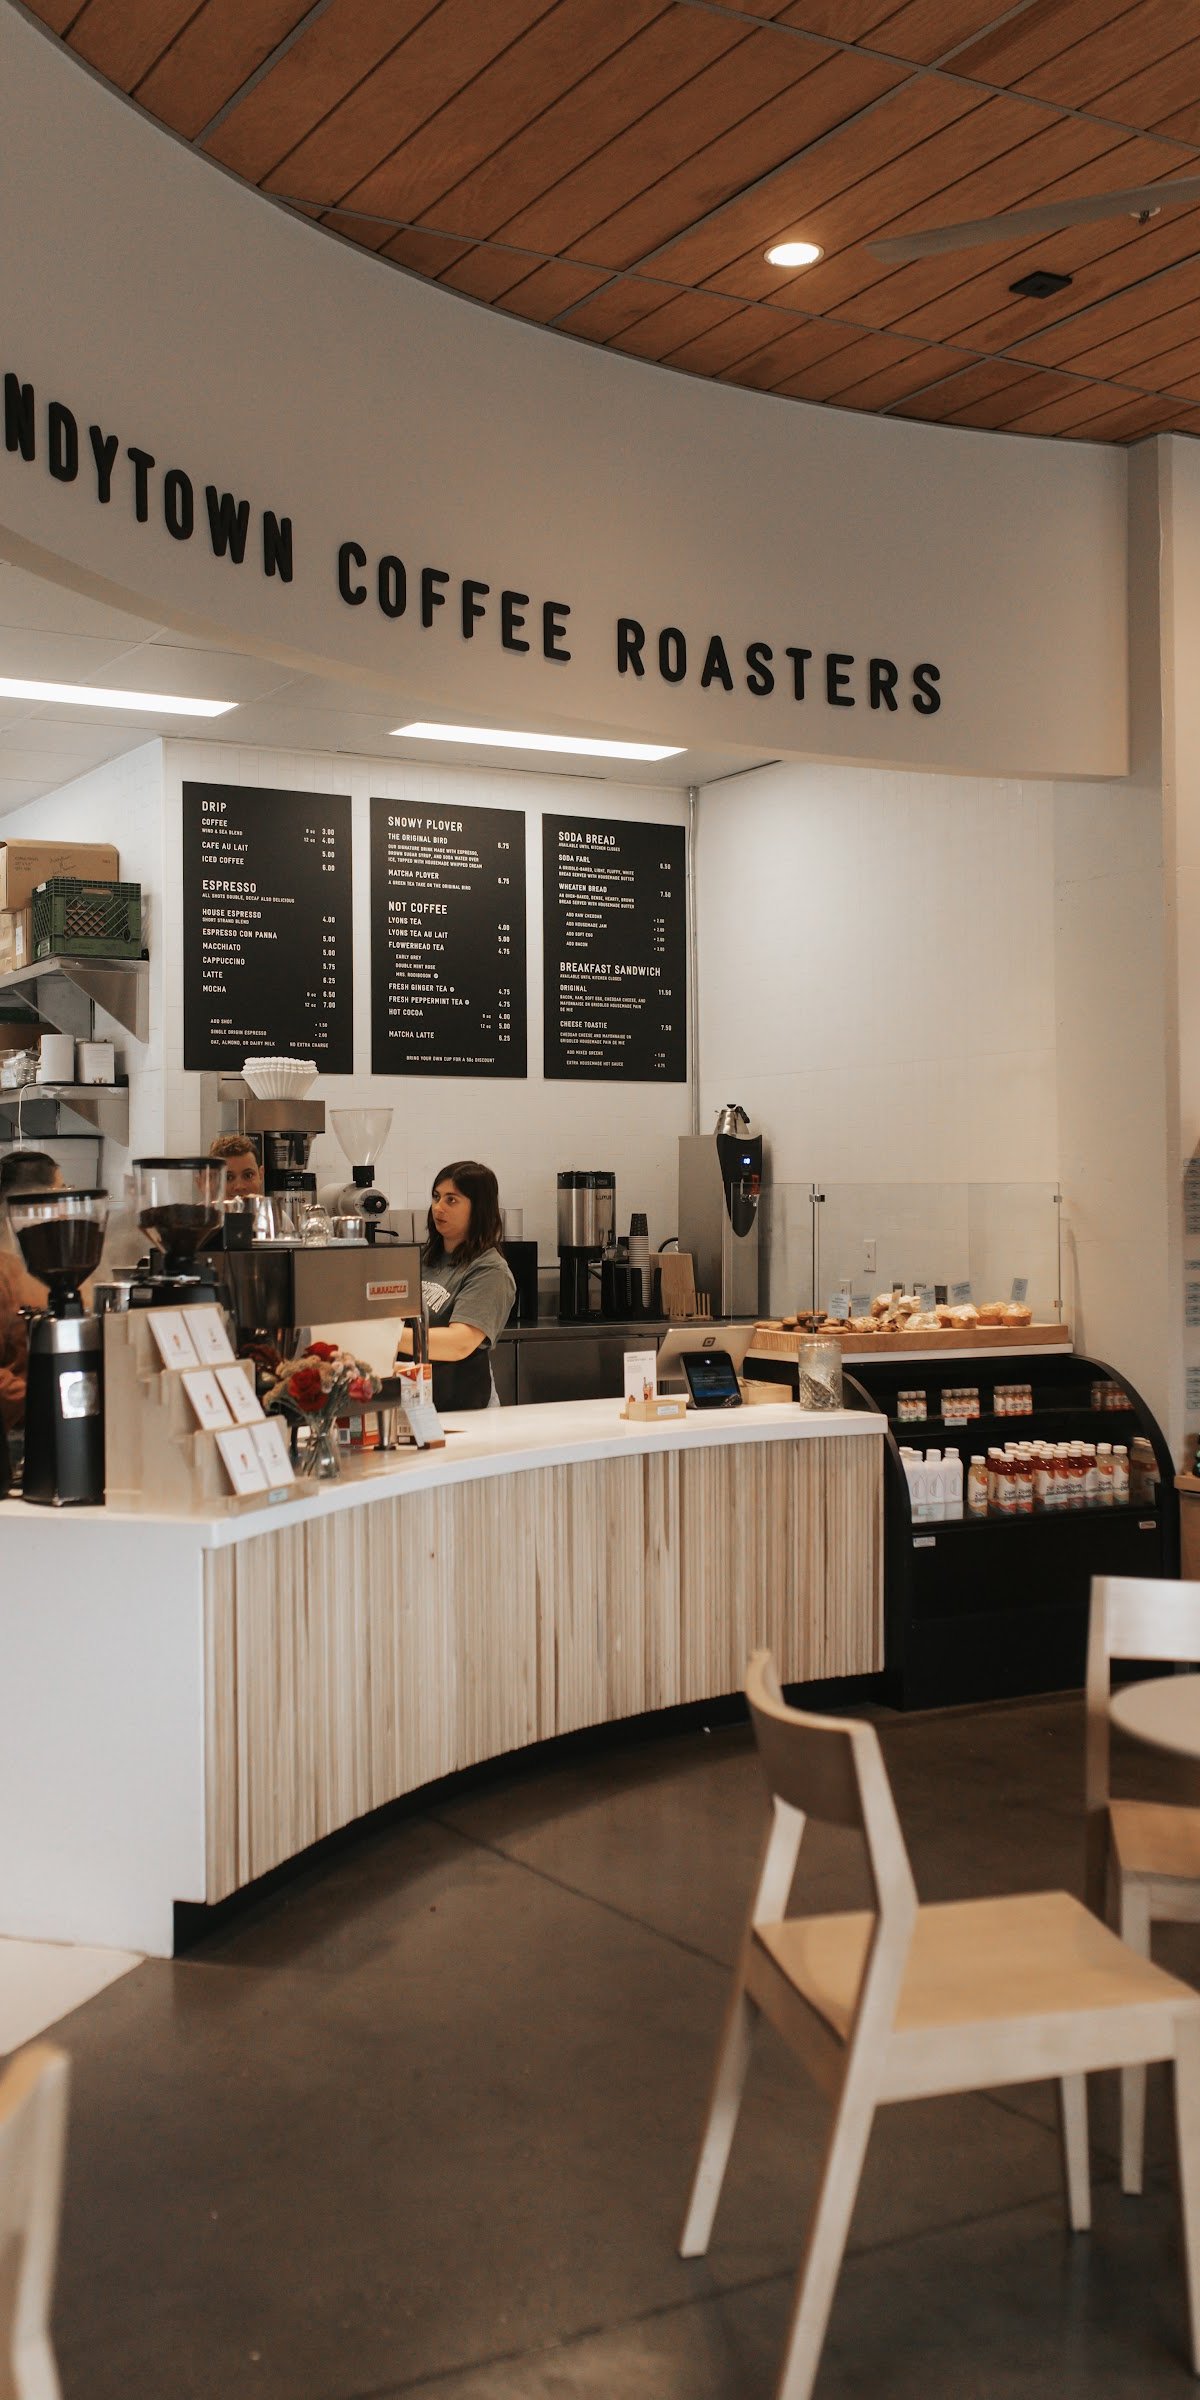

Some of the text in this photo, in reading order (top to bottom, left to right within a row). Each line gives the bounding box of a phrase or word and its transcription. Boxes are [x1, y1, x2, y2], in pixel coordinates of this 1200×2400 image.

[4, 372, 942, 716] NDYTOWN COFFEE ROASTERS
[201, 800, 226, 812] DRIP
[201, 817, 227, 827] COFFEE
[387, 815, 462, 832] SNOWY PLOVER
[321, 836, 334, 844] 4.00
[387, 832, 447, 844] THE ORIGINAL BIRD
[558, 831, 615, 845] SODA BREAD
[201, 841, 248, 851] CAFE AU LAIT
[497, 841, 509, 849] 6.75
[321, 850, 334, 858] 5.00
[558, 853, 590, 863] SODA FARL
[201, 855, 244, 864] ICED COFFEE
[388, 868, 439, 879] MATCHA PLOVER
[202, 879, 256, 893] ESPRESSO
[558, 882, 607, 893] WHEATEN BREAD
[388, 900, 447, 914] NOT COFFEE
[202, 908, 261, 918] HOUSE ESPRESSO
[322, 915, 335, 923] 4.00
[388, 916, 421, 925] LYONS TEA
[202, 927, 237, 937] ESPRESSO
[254, 930, 277, 939] PANNA
[388, 928, 408, 936] LYONS
[409, 929, 421, 937] TEA
[202, 941, 240, 951] MACCHIATO
[388, 940, 430, 950] FLOWERHEAD
[202, 956, 245, 965] CAPPUCCINO
[322, 962, 335, 970] 5.75
[559, 961, 660, 976] BREAKFAST SANDWICH
[202, 970, 222, 978] LATTE
[322, 976, 335, 984] 6.25
[202, 984, 226, 992] MOCHA
[388, 982, 447, 992] FRESH GINGER TEA
[559, 984, 587, 992] ORIGINAL
[388, 995, 408, 1003] FRESH
[410, 996, 449, 1004] PEPPERMINT
[402, 1008, 423, 1016] COCOA
